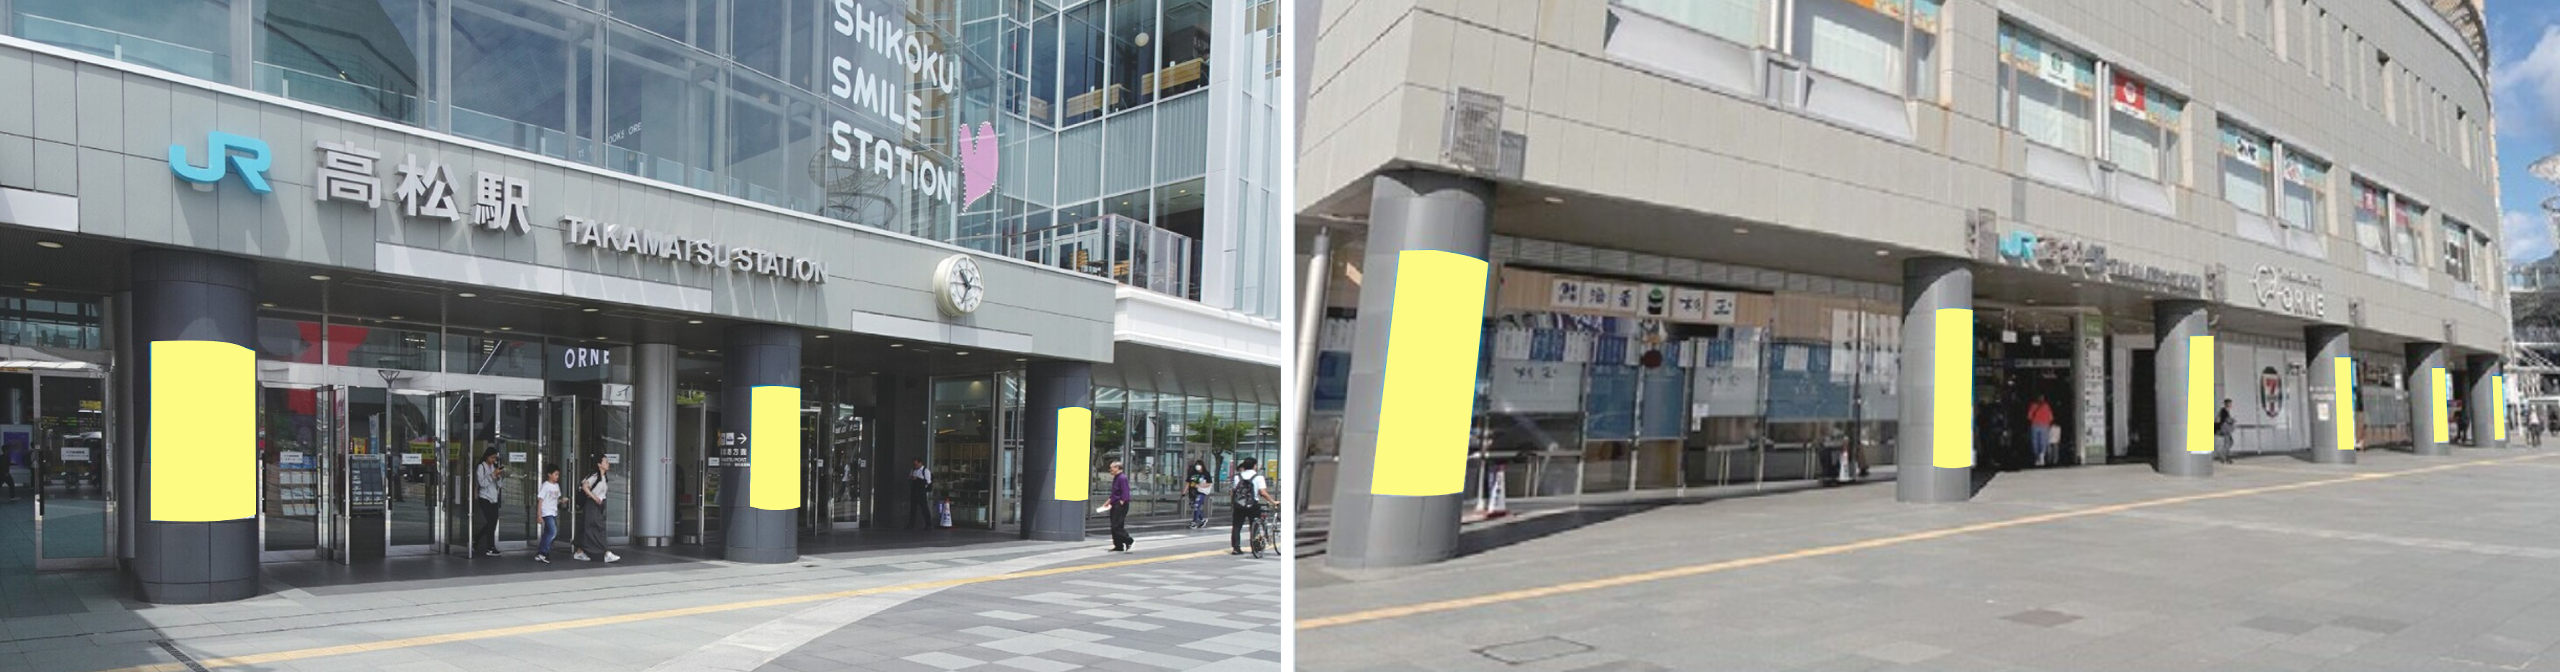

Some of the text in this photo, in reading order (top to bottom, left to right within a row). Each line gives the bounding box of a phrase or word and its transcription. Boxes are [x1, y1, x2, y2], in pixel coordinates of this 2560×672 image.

[834, 0, 953, 94] SHIKOKU
[832, 56, 922, 133] SMILE
[169, 131, 272, 194] JR
[313, 140, 531, 235] 高松駅
[832, 120, 952, 204] STATION
[558, 214, 829, 284] TAKAMATSU STATION
[565, 347, 609, 369] ORNE
